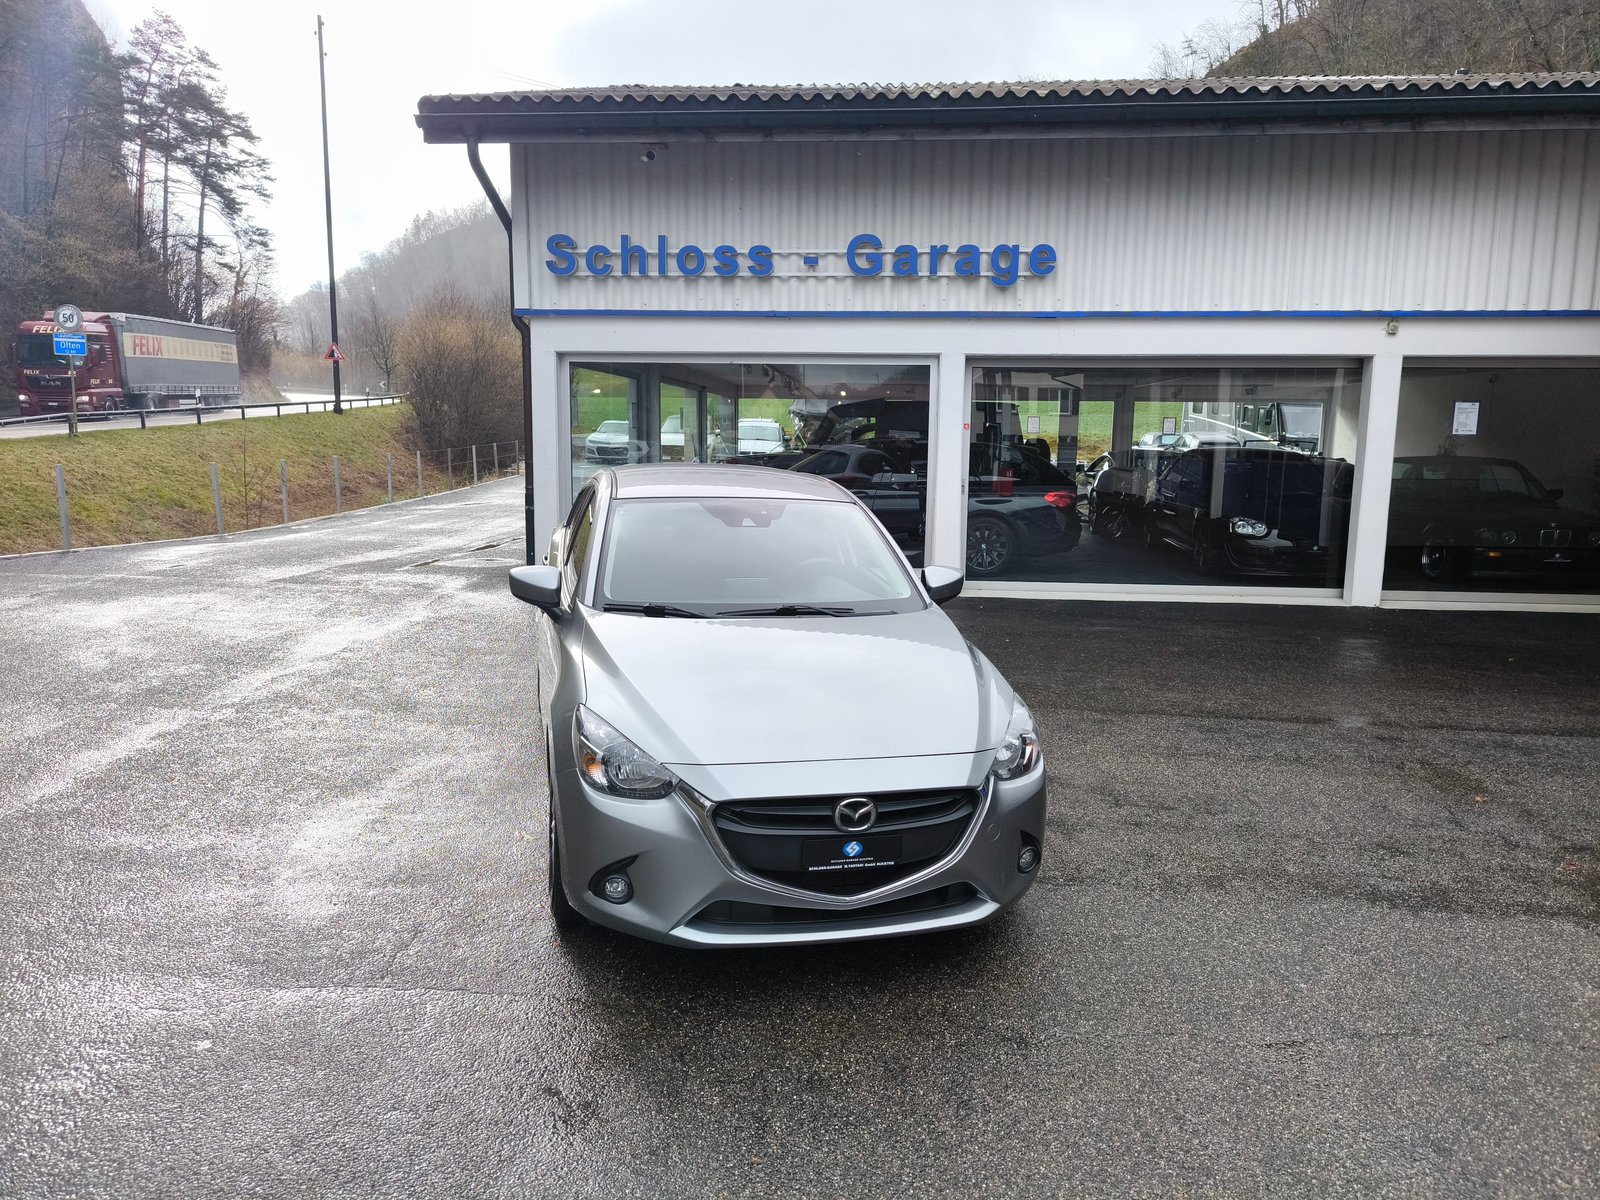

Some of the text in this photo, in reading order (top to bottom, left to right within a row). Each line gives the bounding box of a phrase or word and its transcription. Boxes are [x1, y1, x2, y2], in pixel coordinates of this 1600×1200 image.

[545, 233, 1058, 288] Schloss - Garage
[62, 313, 74, 323] 50
[60, 341, 81, 349] Olten
[133, 335, 163, 357] FELIX
